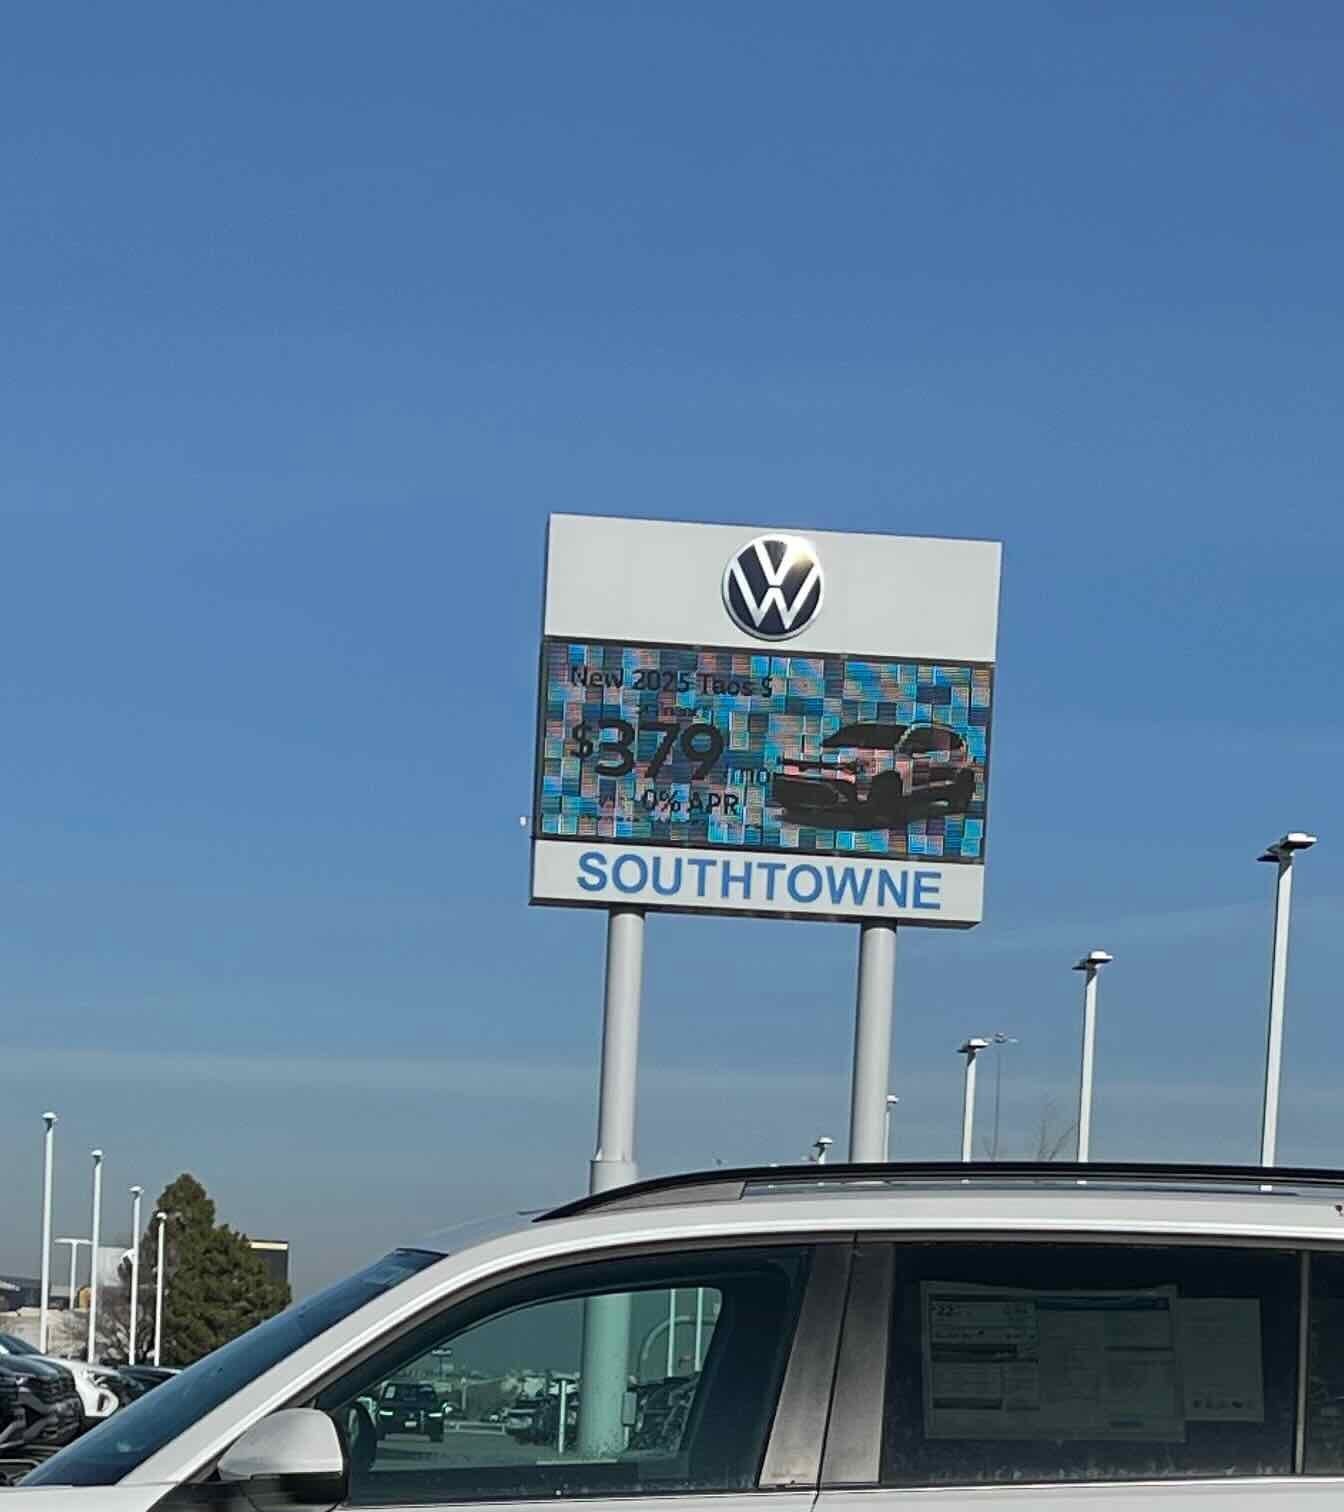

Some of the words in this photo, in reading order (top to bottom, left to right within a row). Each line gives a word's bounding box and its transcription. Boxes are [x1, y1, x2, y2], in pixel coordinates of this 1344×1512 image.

[724, 535, 823, 639] VW
[570, 666, 624, 688] New
[632, 669, 691, 692] 2025
[696, 673, 753, 697] Taos
[570, 718, 723, 781] $379
[642, 788, 681, 813] 0%
[687, 792, 739, 815] APR
[577, 851, 942, 910] SOUTHTOWNE
